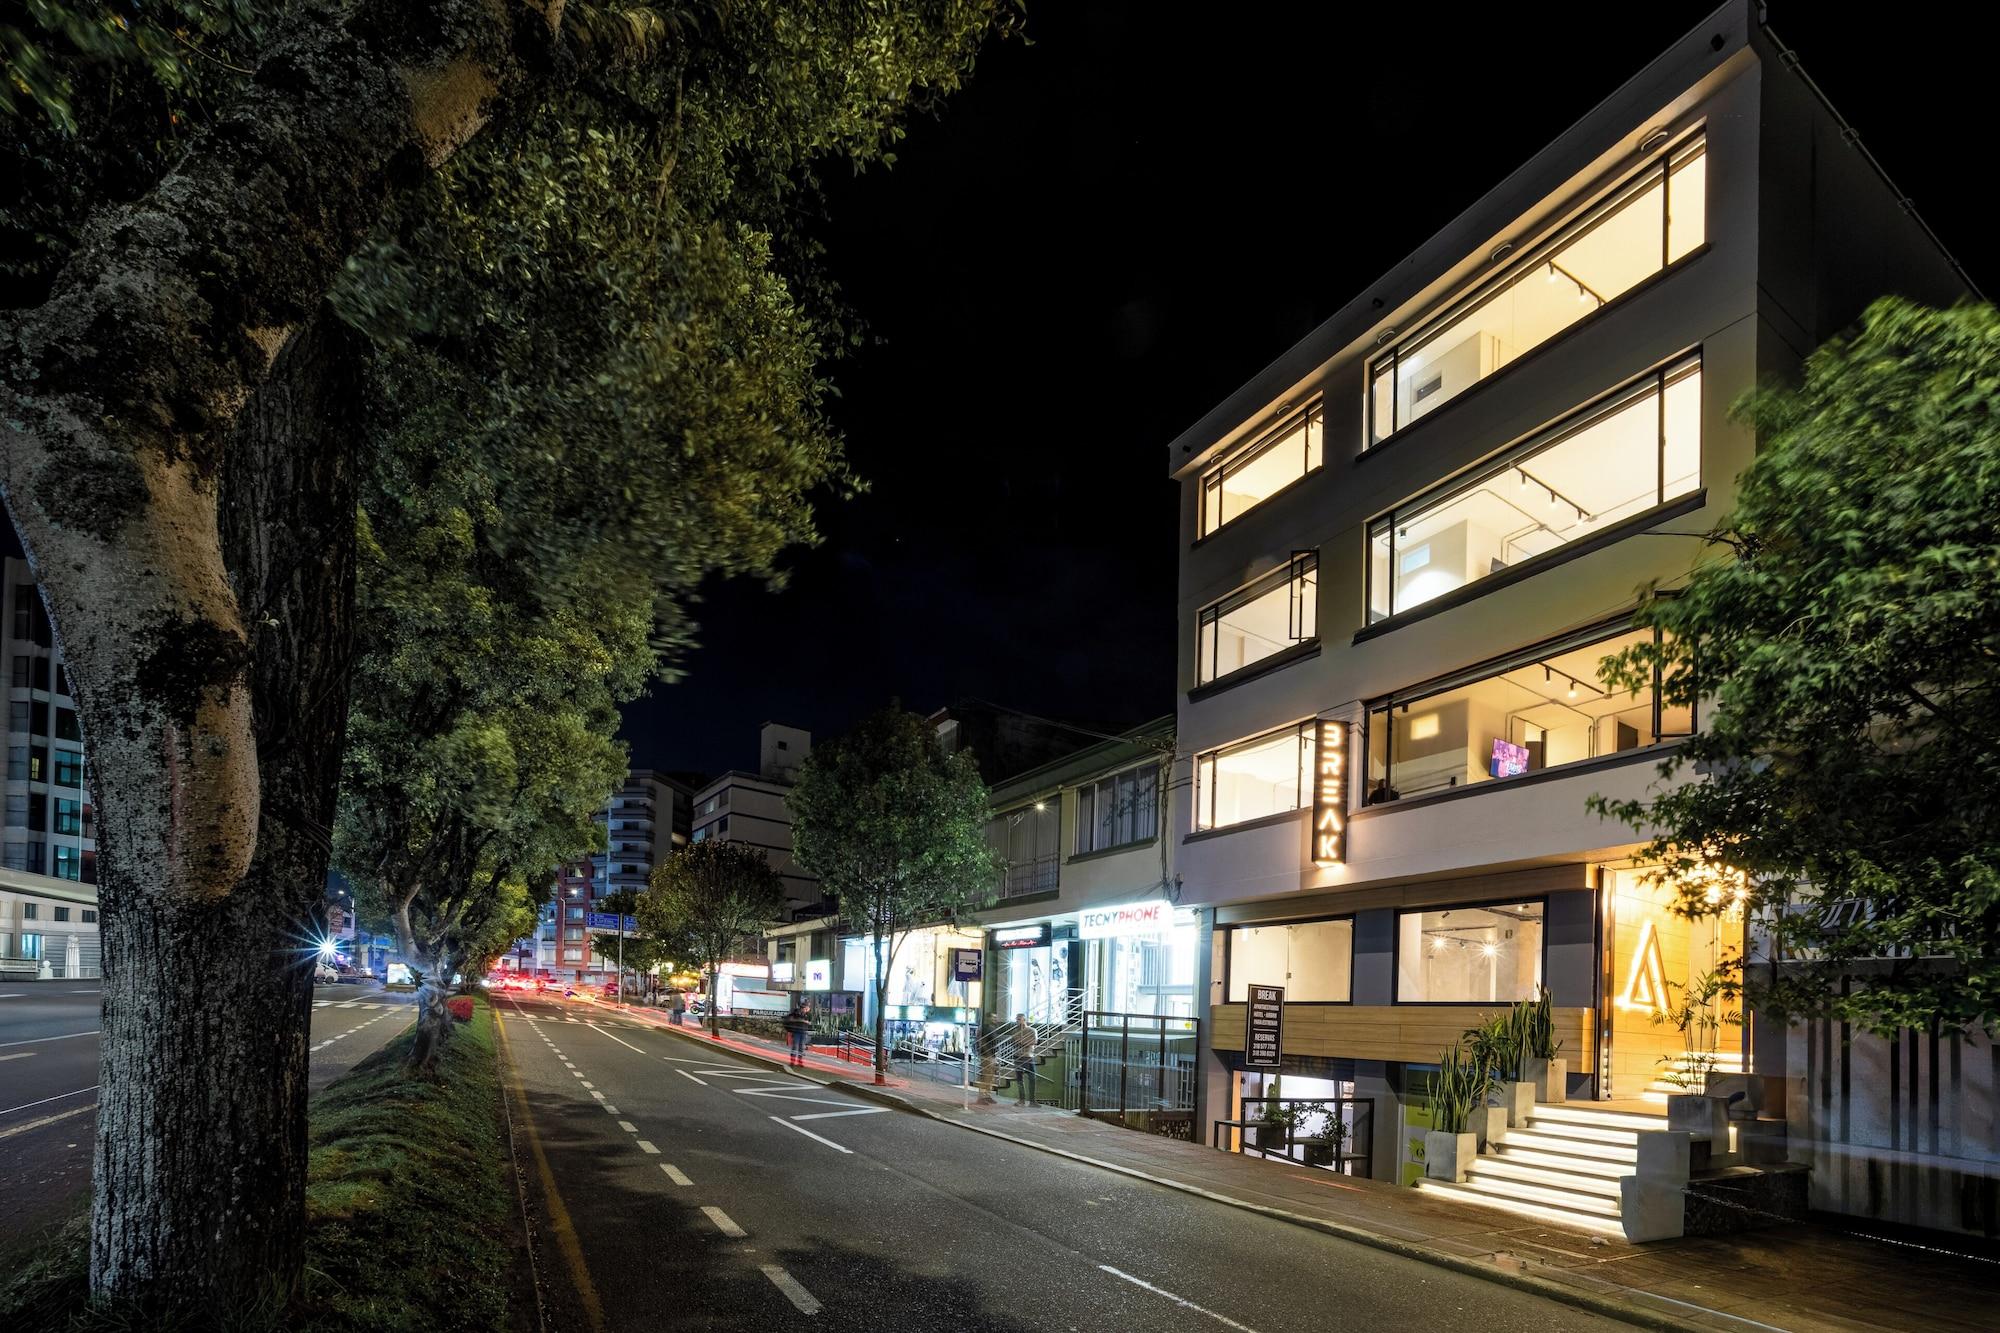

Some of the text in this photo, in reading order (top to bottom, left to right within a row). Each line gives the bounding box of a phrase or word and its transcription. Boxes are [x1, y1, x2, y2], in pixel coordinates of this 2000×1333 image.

[1318, 724, 1343, 859] BREAK
[1083, 905, 1161, 928] TECNYPHONE
[1257, 989, 1277, 1001] BREAK
